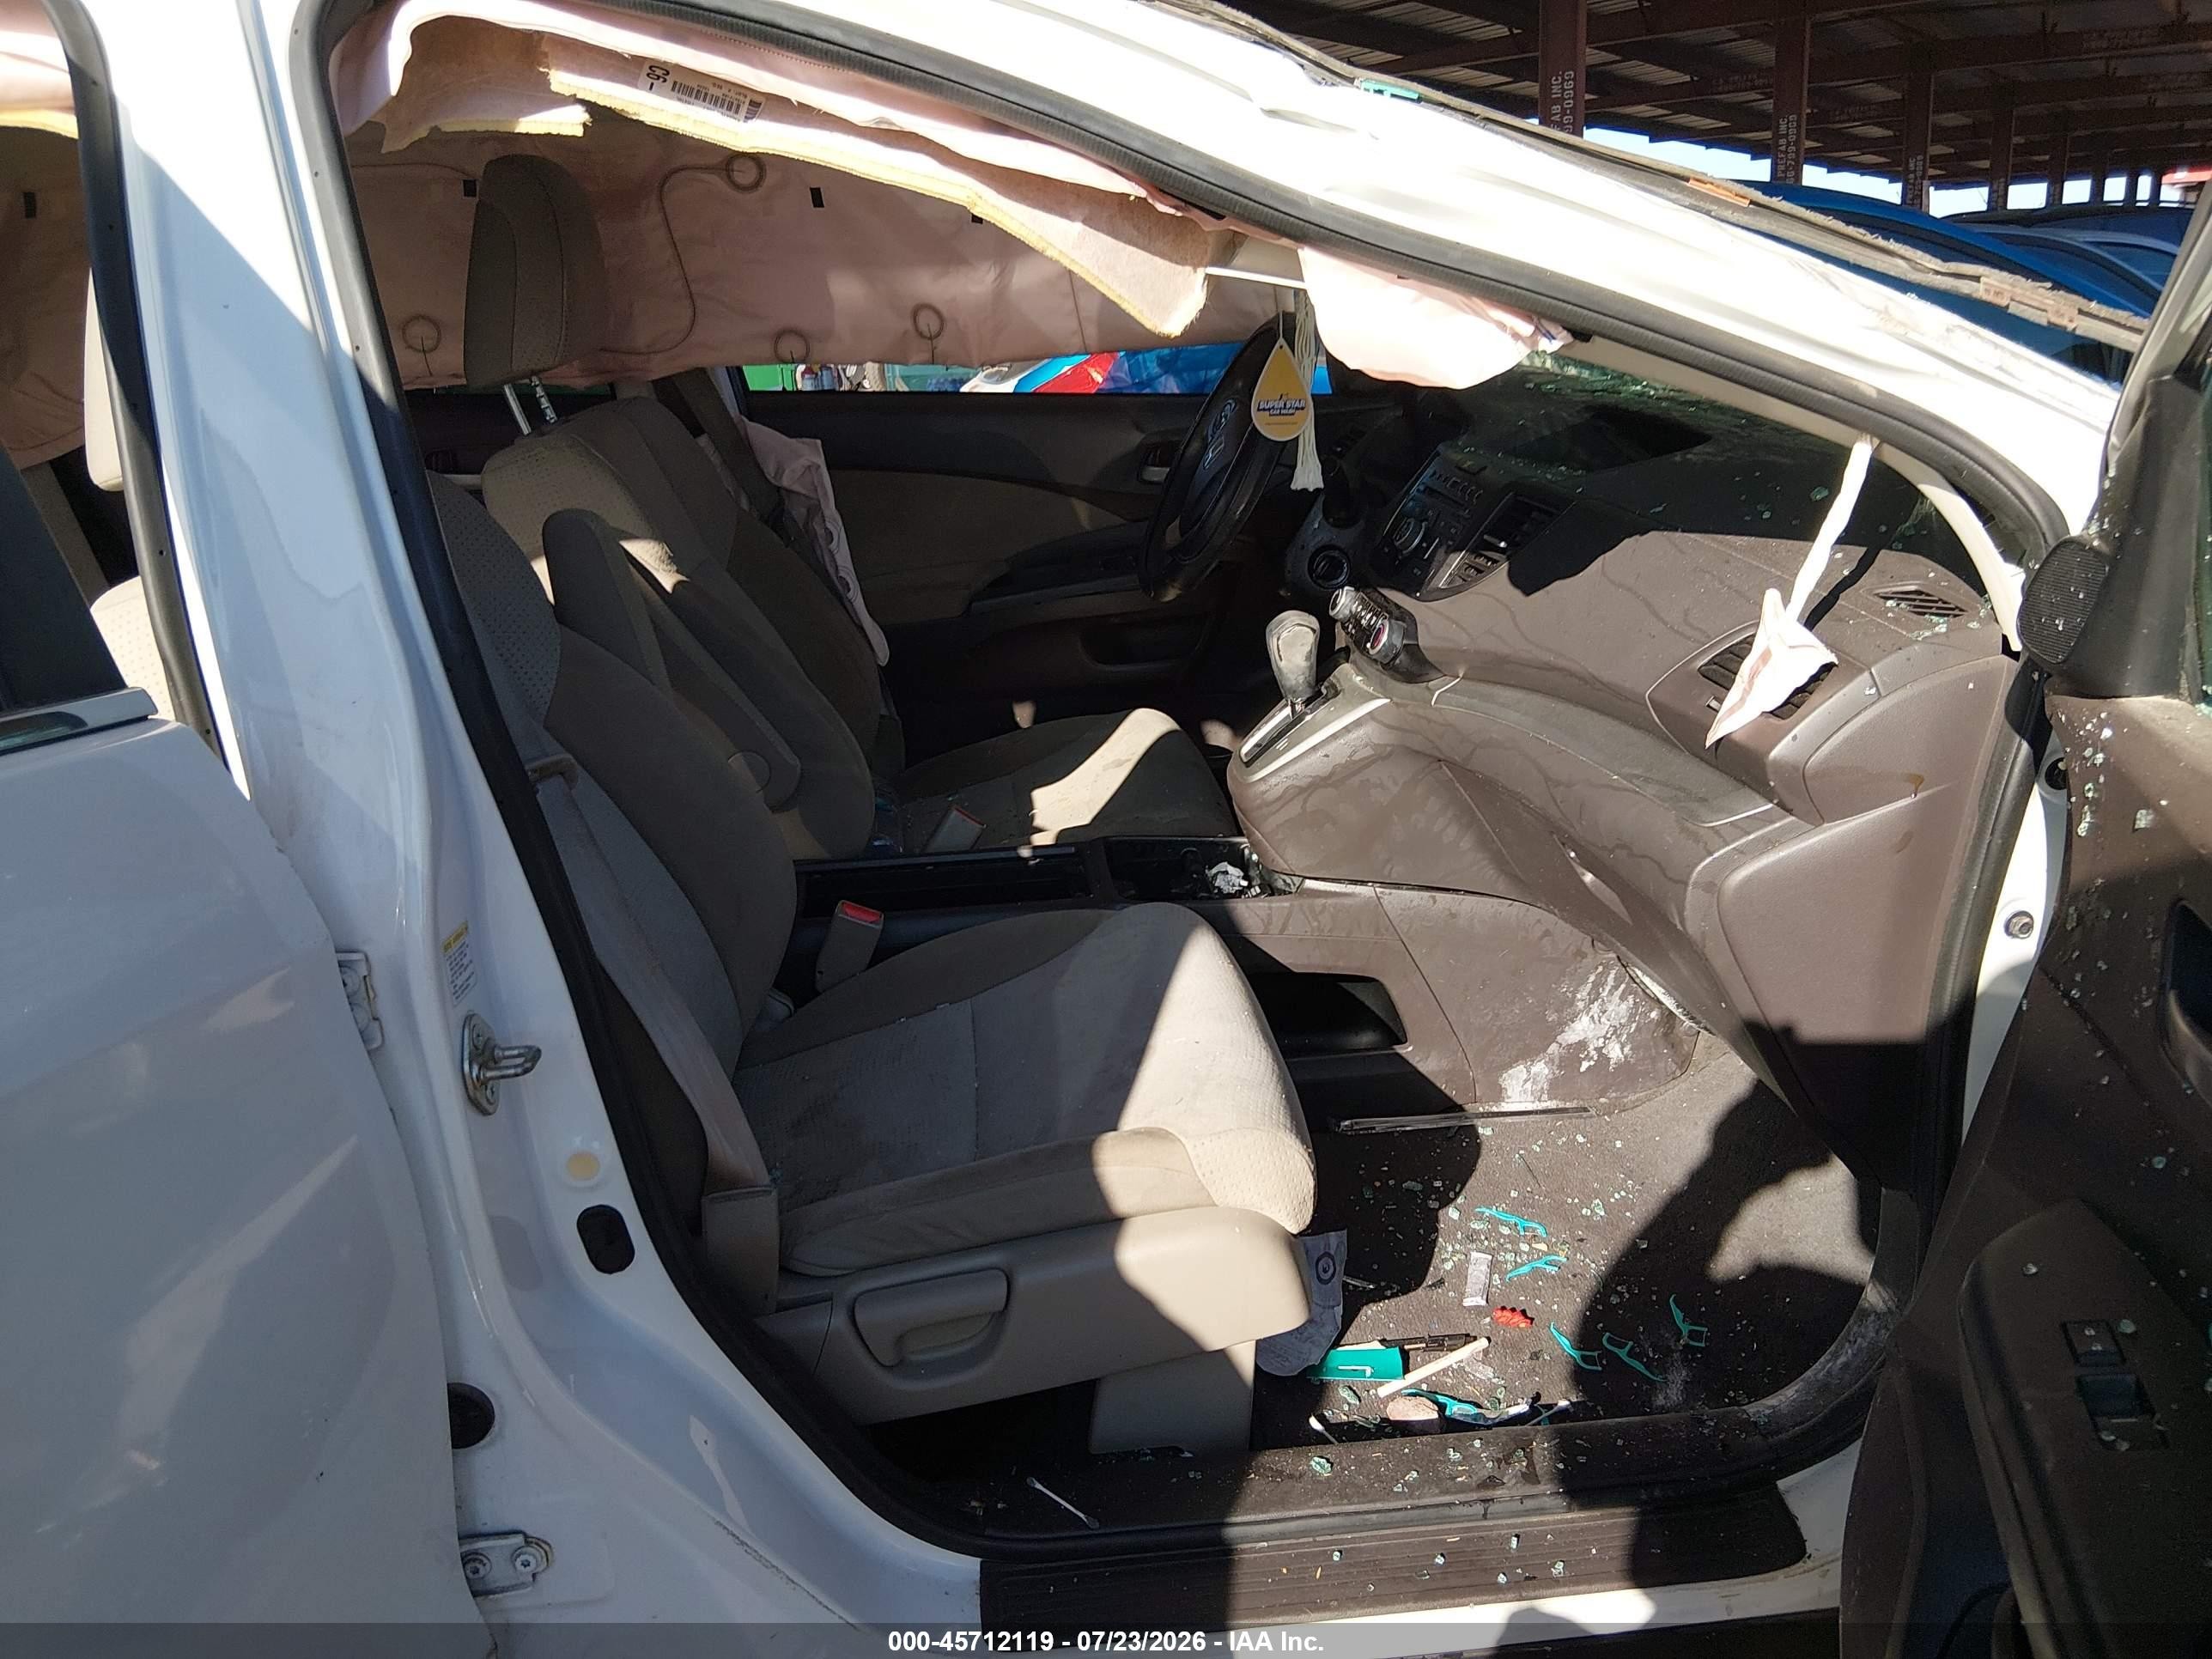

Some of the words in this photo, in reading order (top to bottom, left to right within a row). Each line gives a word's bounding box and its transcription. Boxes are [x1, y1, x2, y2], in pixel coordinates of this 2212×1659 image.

[1551, 70, 1562, 98] INC.
[1257, 399, 1285, 410] SUPER
[1285, 398, 1306, 410] STAR
